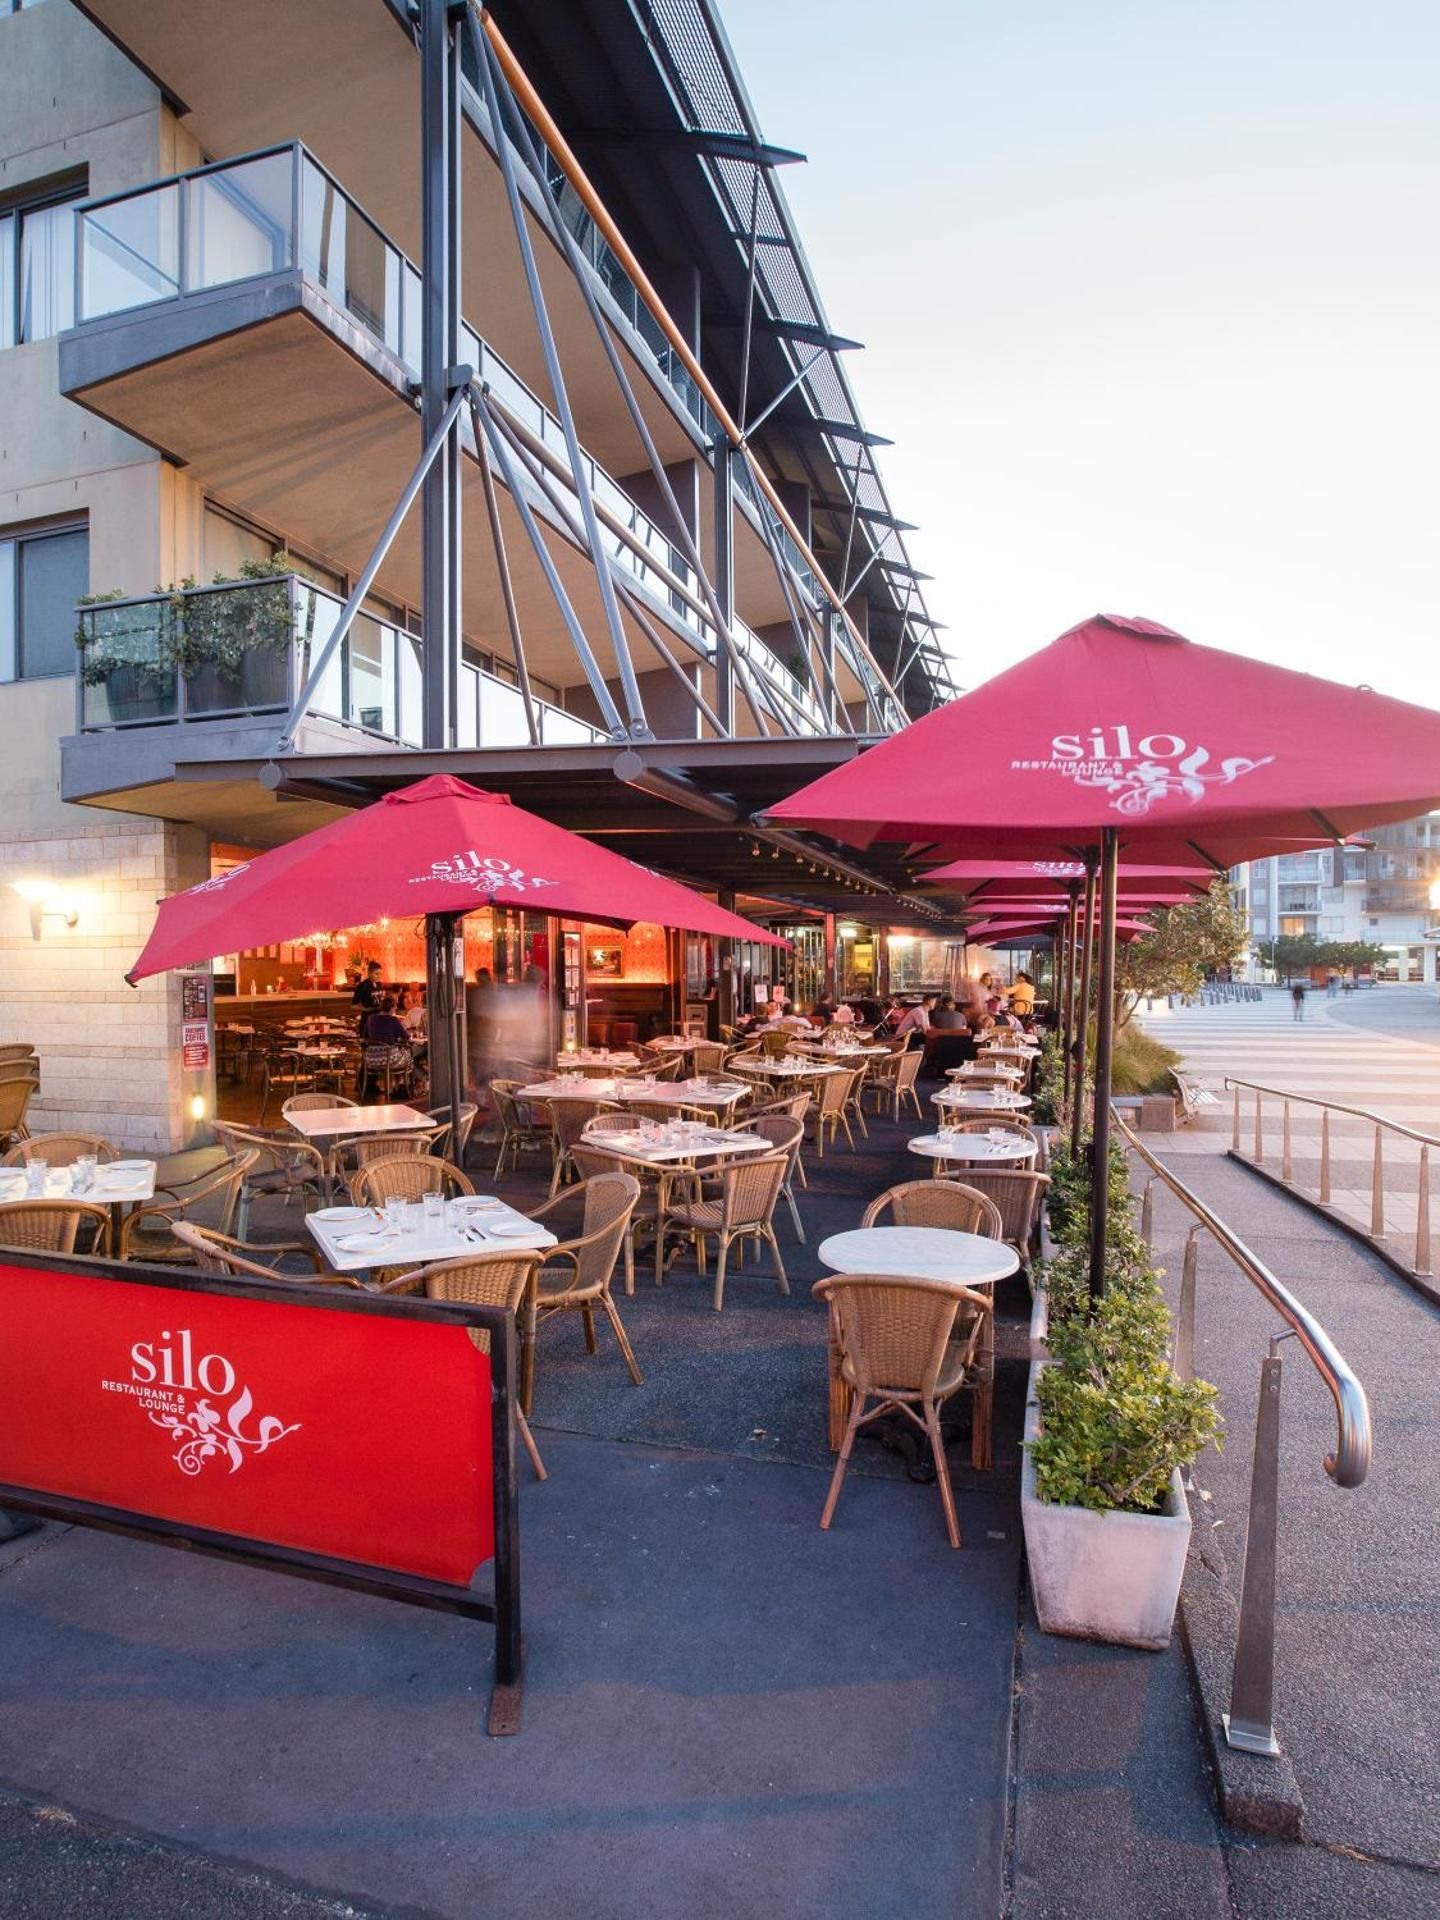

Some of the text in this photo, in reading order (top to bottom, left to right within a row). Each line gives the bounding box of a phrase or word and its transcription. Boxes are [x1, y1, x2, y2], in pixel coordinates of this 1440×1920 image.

[1052, 725, 1187, 761] silo
[1011, 760, 1107, 770] RESTAURANT
[431, 850, 511, 873] silo
[131, 1329, 236, 1396] silo
[101, 1380, 185, 1404] RESTAURANT &
[139, 1398, 185, 1415] LOUNGE
